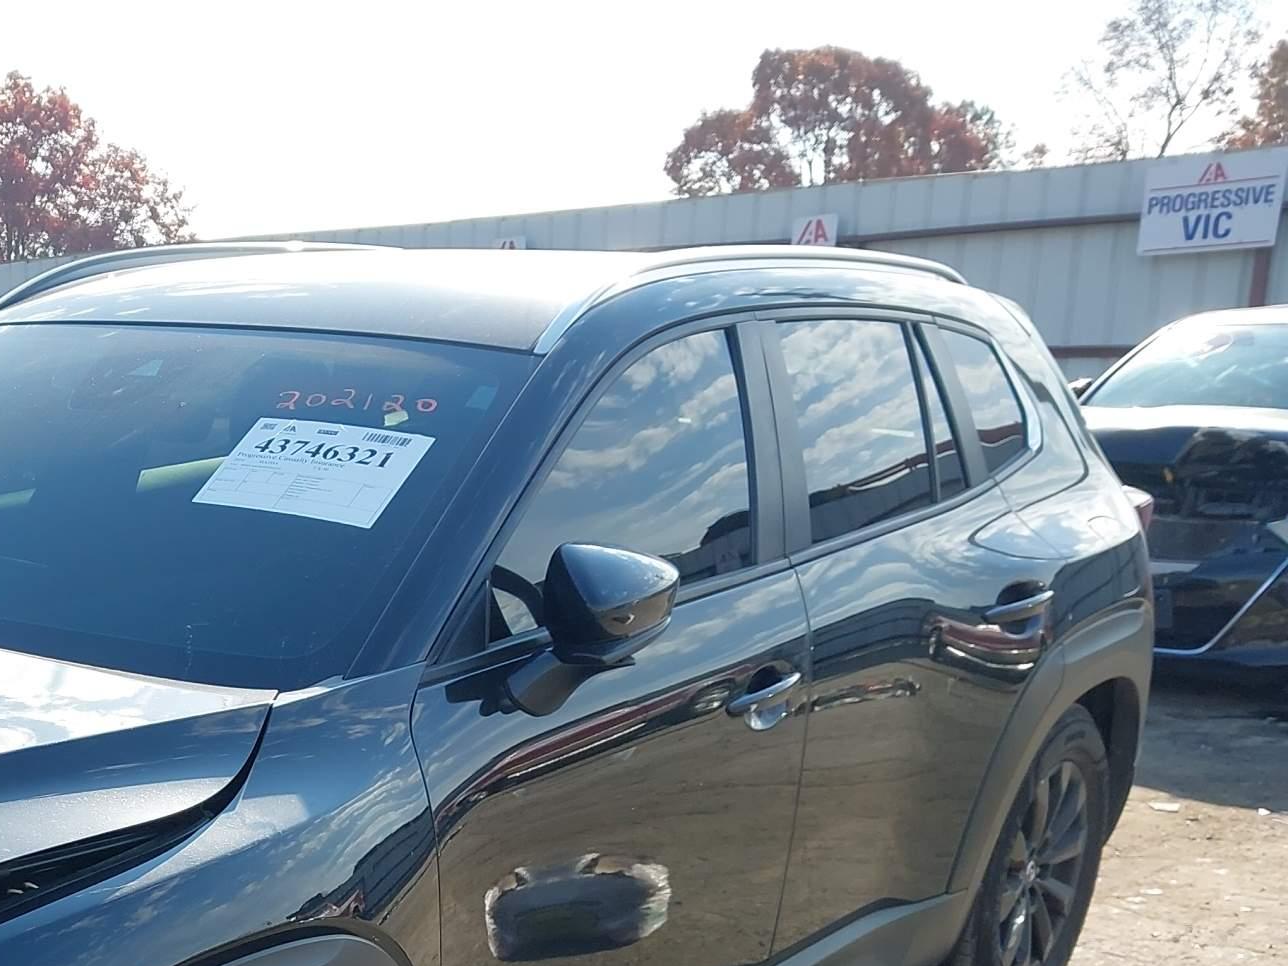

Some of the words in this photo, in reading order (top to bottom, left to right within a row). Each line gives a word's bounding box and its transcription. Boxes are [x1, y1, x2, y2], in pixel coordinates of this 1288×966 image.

[1147, 184, 1276, 215] PROGRESSIVE
[1182, 211, 1233, 241] VIC
[254, 436, 394, 468] 43746321
